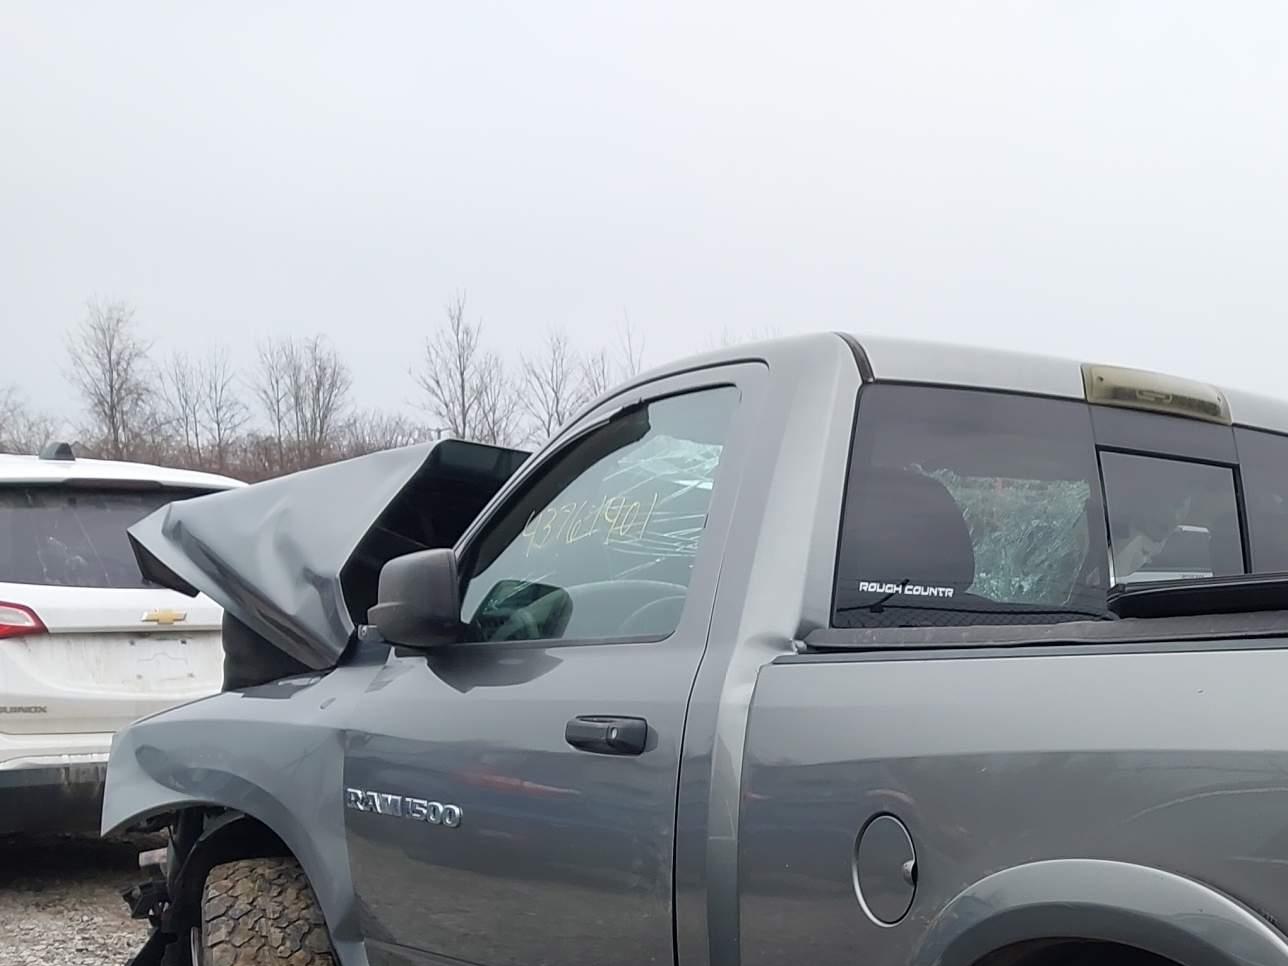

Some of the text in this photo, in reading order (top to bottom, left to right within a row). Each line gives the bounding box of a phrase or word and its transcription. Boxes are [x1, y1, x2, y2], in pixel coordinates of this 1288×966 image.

[859, 581, 903, 594] ROUGH
[346, 787, 464, 829] RAM 1500
